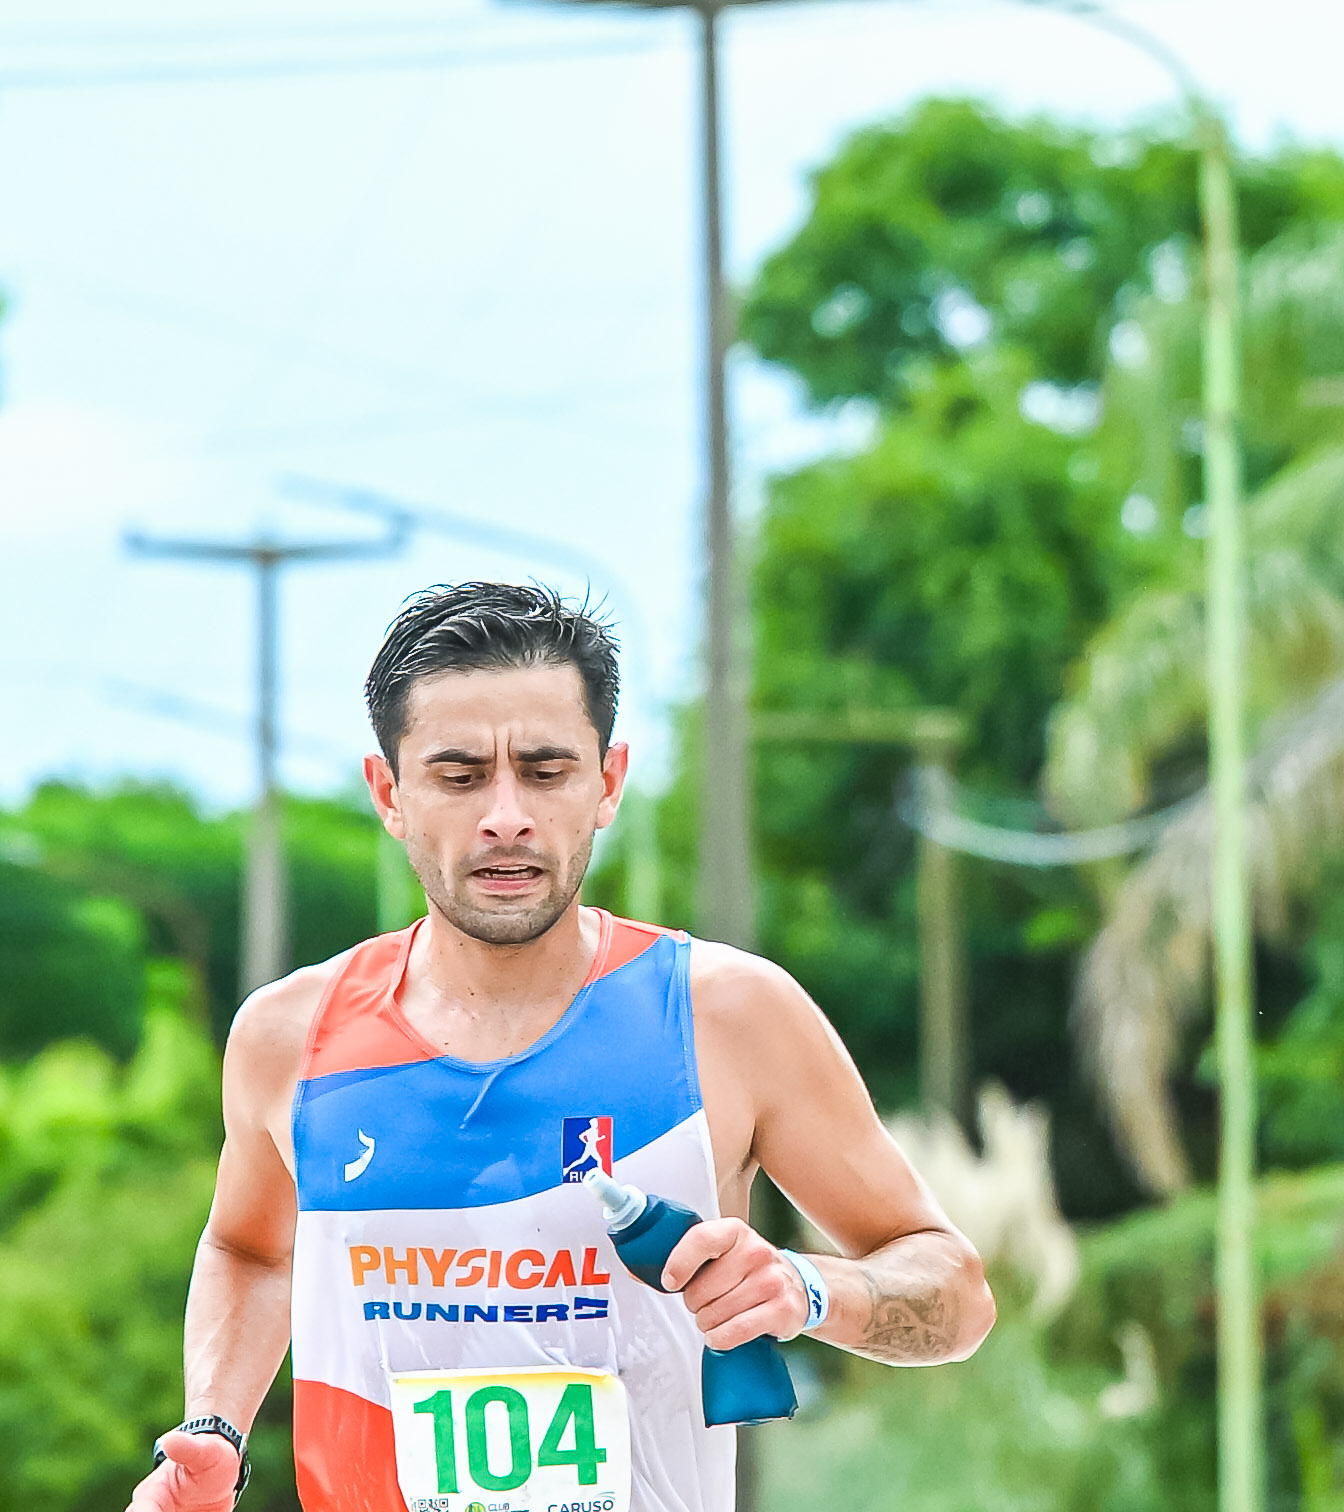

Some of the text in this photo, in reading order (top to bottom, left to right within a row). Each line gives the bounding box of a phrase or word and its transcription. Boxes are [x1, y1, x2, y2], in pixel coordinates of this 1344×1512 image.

[349, 1246, 611, 1289] PHYSICAL
[363, 1296, 609, 1323] RUNNERS
[413, 1383, 607, 1494] 104
